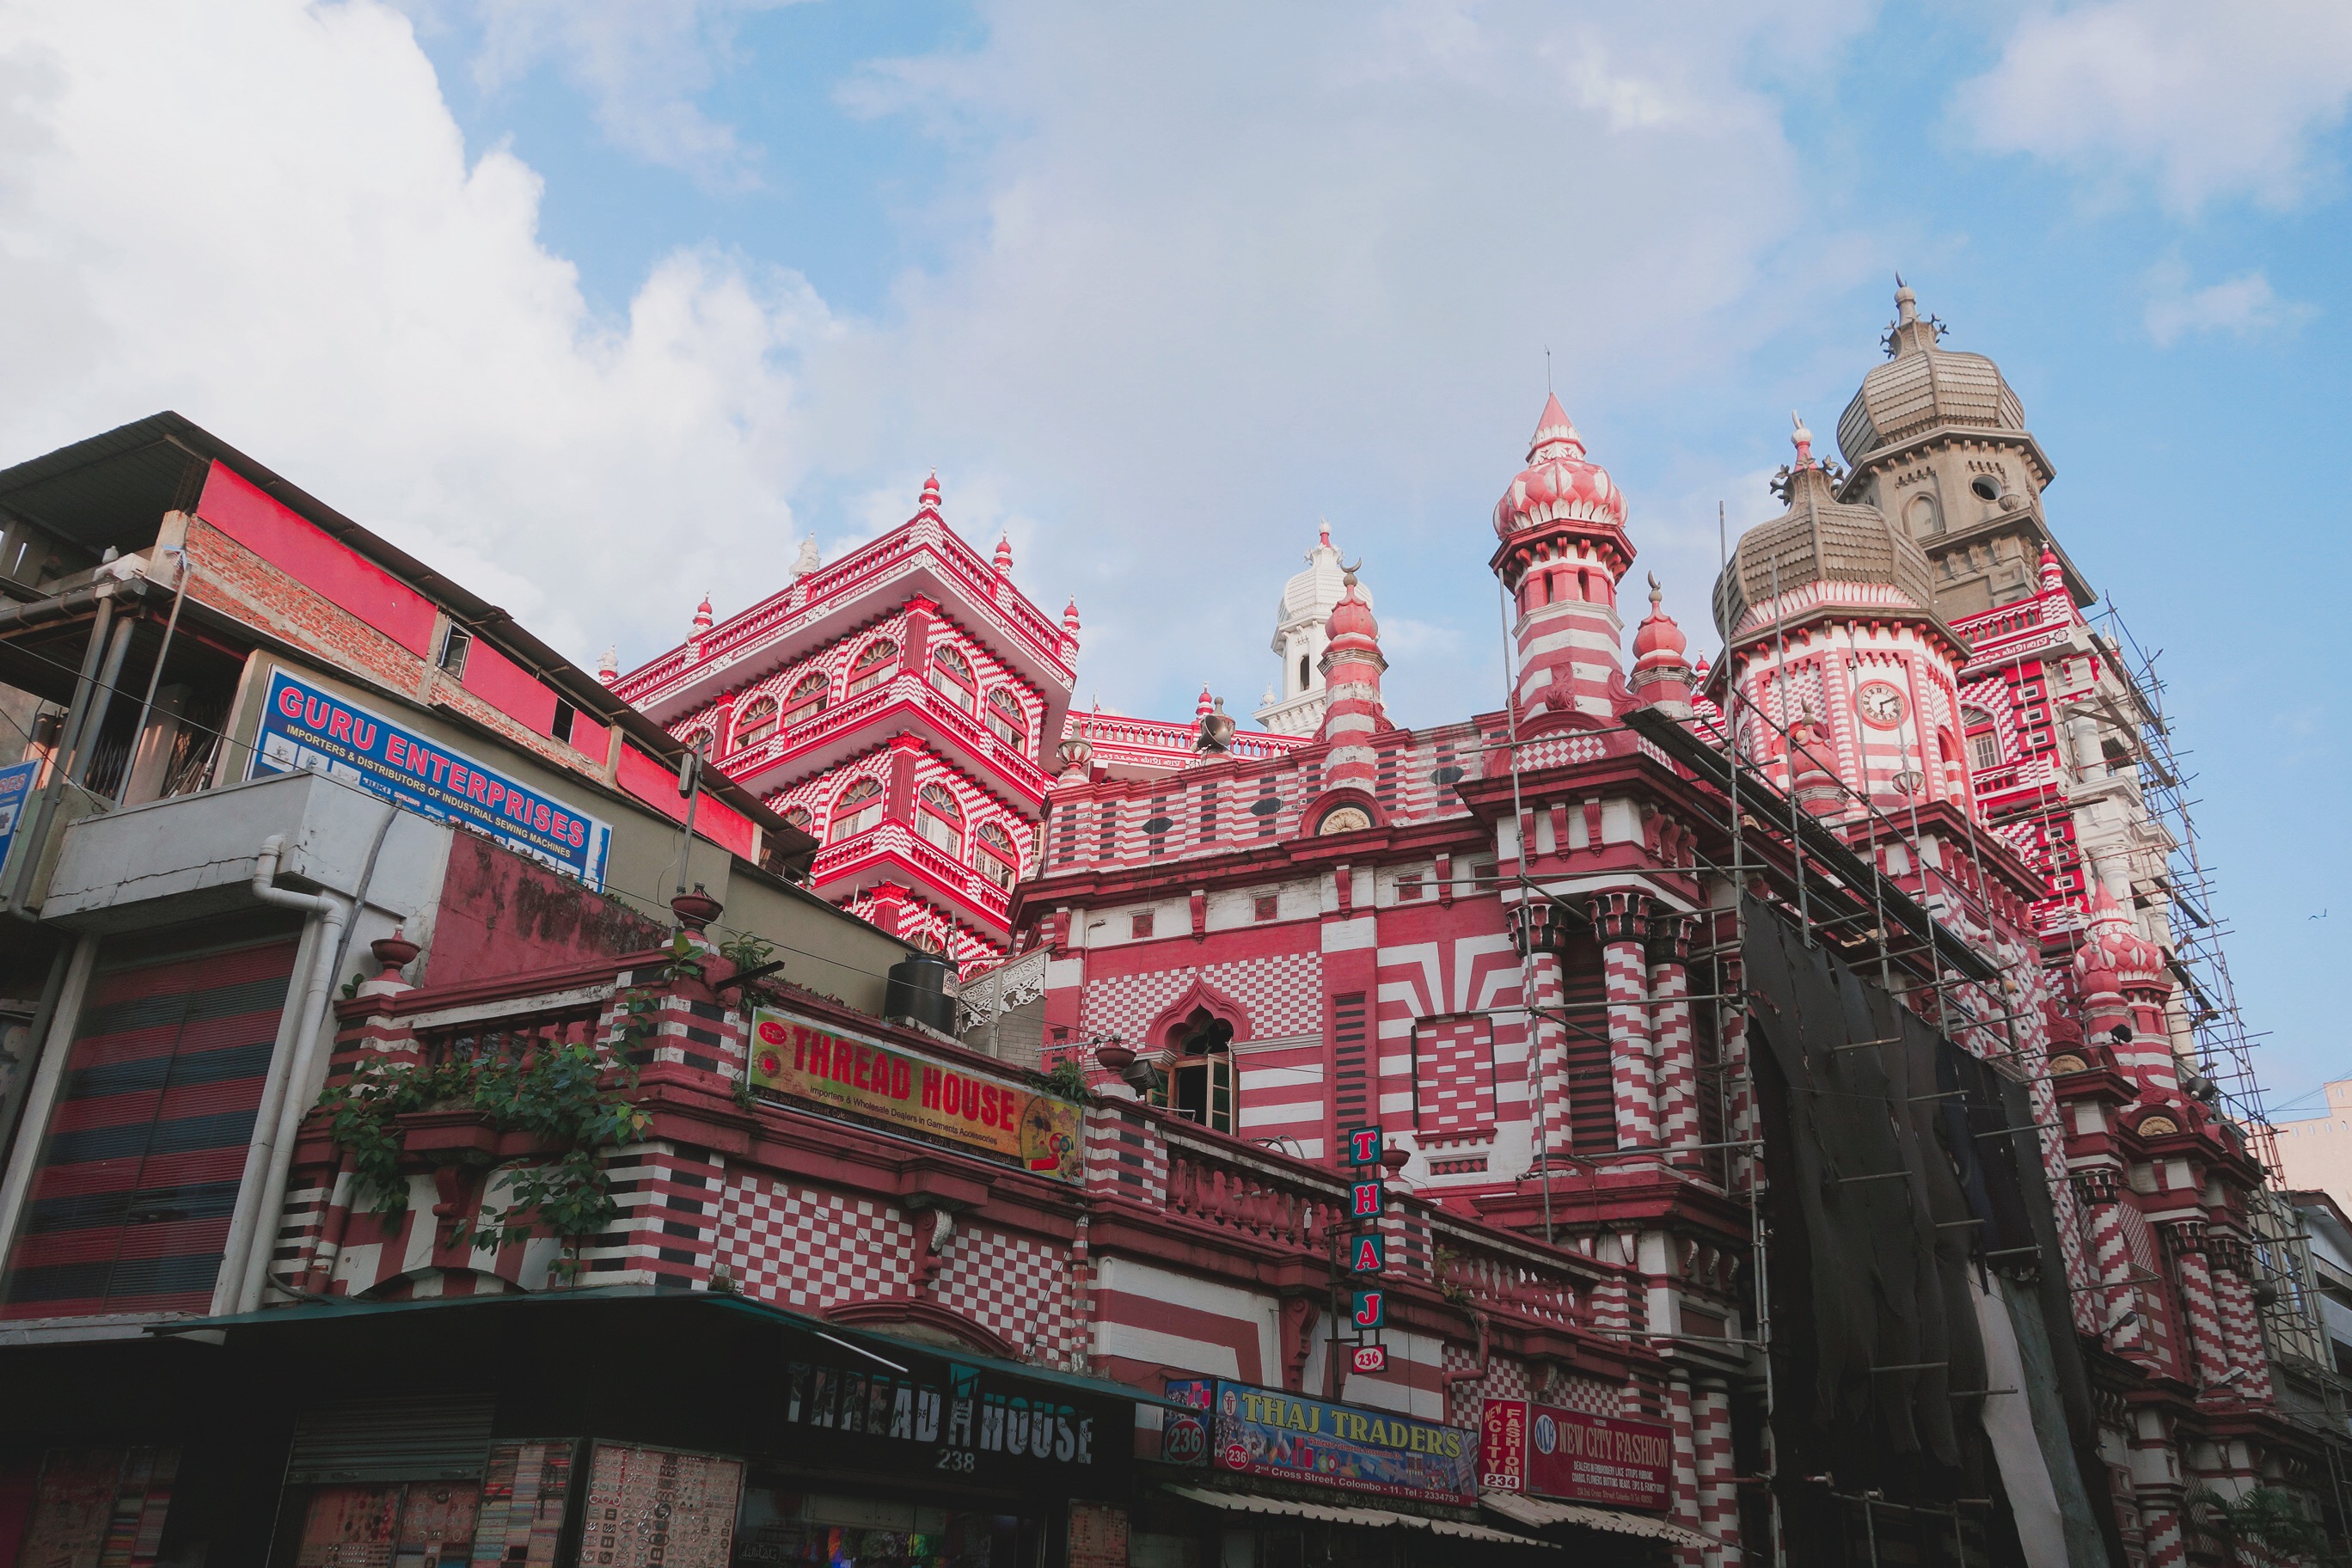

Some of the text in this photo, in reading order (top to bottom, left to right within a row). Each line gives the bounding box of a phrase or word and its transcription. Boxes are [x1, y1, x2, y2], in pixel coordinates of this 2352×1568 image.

[278, 686, 585, 848] GURU ENTERPRISES
[286, 724, 346, 758] IMPORTERS
[347, 750, 355, 763] &
[357, 755, 426, 791] DISTRIBUTORS
[427, 785, 441, 799] OF
[442, 791, 494, 824] INDUSTRIAL
[495, 816, 528, 842] SEWING
[528, 830, 572, 859] MACHINES
[793, 1026, 1015, 1132] THREAD HOUSE
[810, 1085, 844, 1105] Importers
[846, 1095, 851, 1104] &
[853, 1097, 890, 1116] Wholesale
[891, 1106, 918, 1124] Dealers
[926, 1118, 959, 1136] Garments
[959, 1128, 997, 1146] Accessories
[1352, 1130, 1381, 1325] THAJ
[1358, 1351, 1379, 1367] 236
[784, 1361, 940, 1442] THREAD
[979, 1391, 1094, 1464] HOUSE
[1241, 1391, 1462, 1459] THAJ TRADERS
[1485, 1402, 1503, 1423] NEW
[935, 1449, 975, 1473] 238
[1170, 1426, 1202, 1455] 236
[1228, 1449, 1246, 1463] 236
[1308, 1436, 1336, 1449] Wholesale
[1487, 1419, 1503, 1473] CITY
[1505, 1408, 1522, 1476] FASHION
[1559, 1422, 1669, 1468] NEW CITY FASHION
[1254, 1465, 1270, 1473] 2nd
[1271, 1467, 1302, 1480] Cross
[1304, 1472, 1338, 1485] Street,
[1338, 1477, 1381, 1492] Colombo
[1404, 1487, 1417, 1498] Tel
[1424, 1489, 1460, 1504] 2334793
[1487, 1475, 1516, 1487] 234
